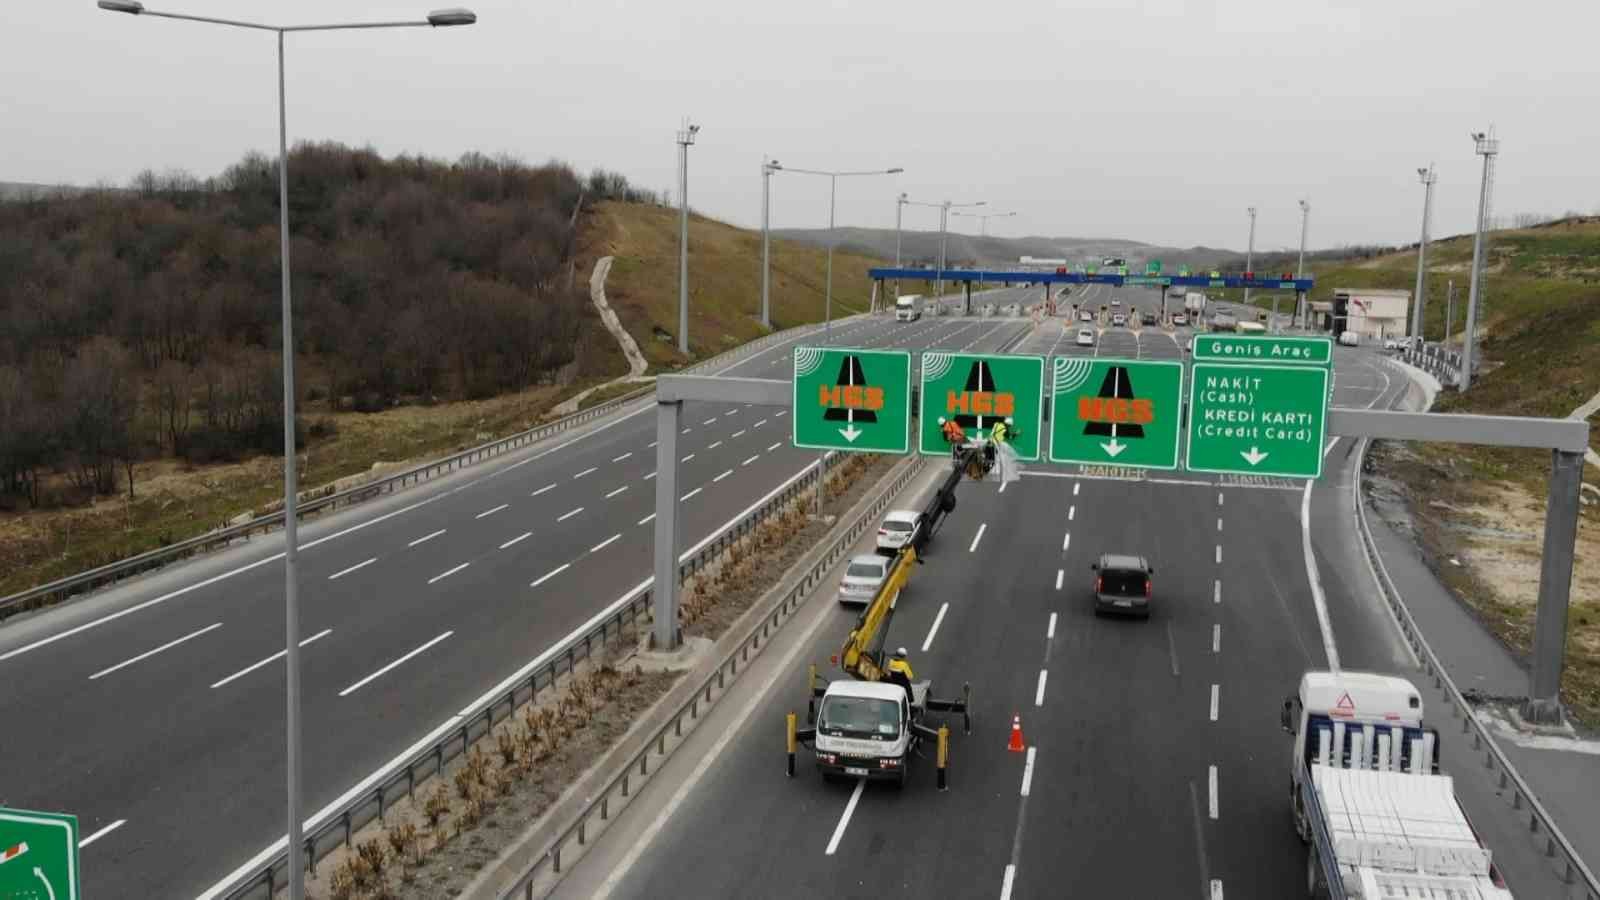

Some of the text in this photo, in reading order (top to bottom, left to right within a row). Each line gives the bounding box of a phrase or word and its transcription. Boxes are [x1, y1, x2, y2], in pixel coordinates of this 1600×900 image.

[1271, 343, 1311, 358] Araç
[819, 384, 884, 410] HGS
[947, 390, 1014, 416] HGS
[1200, 390, 1254, 406] (Cash)
[1079, 397, 1153, 424] HGS
[1204, 408, 1312, 425] KREDİ KARTI
[1265, 427, 1312, 443] Card)
